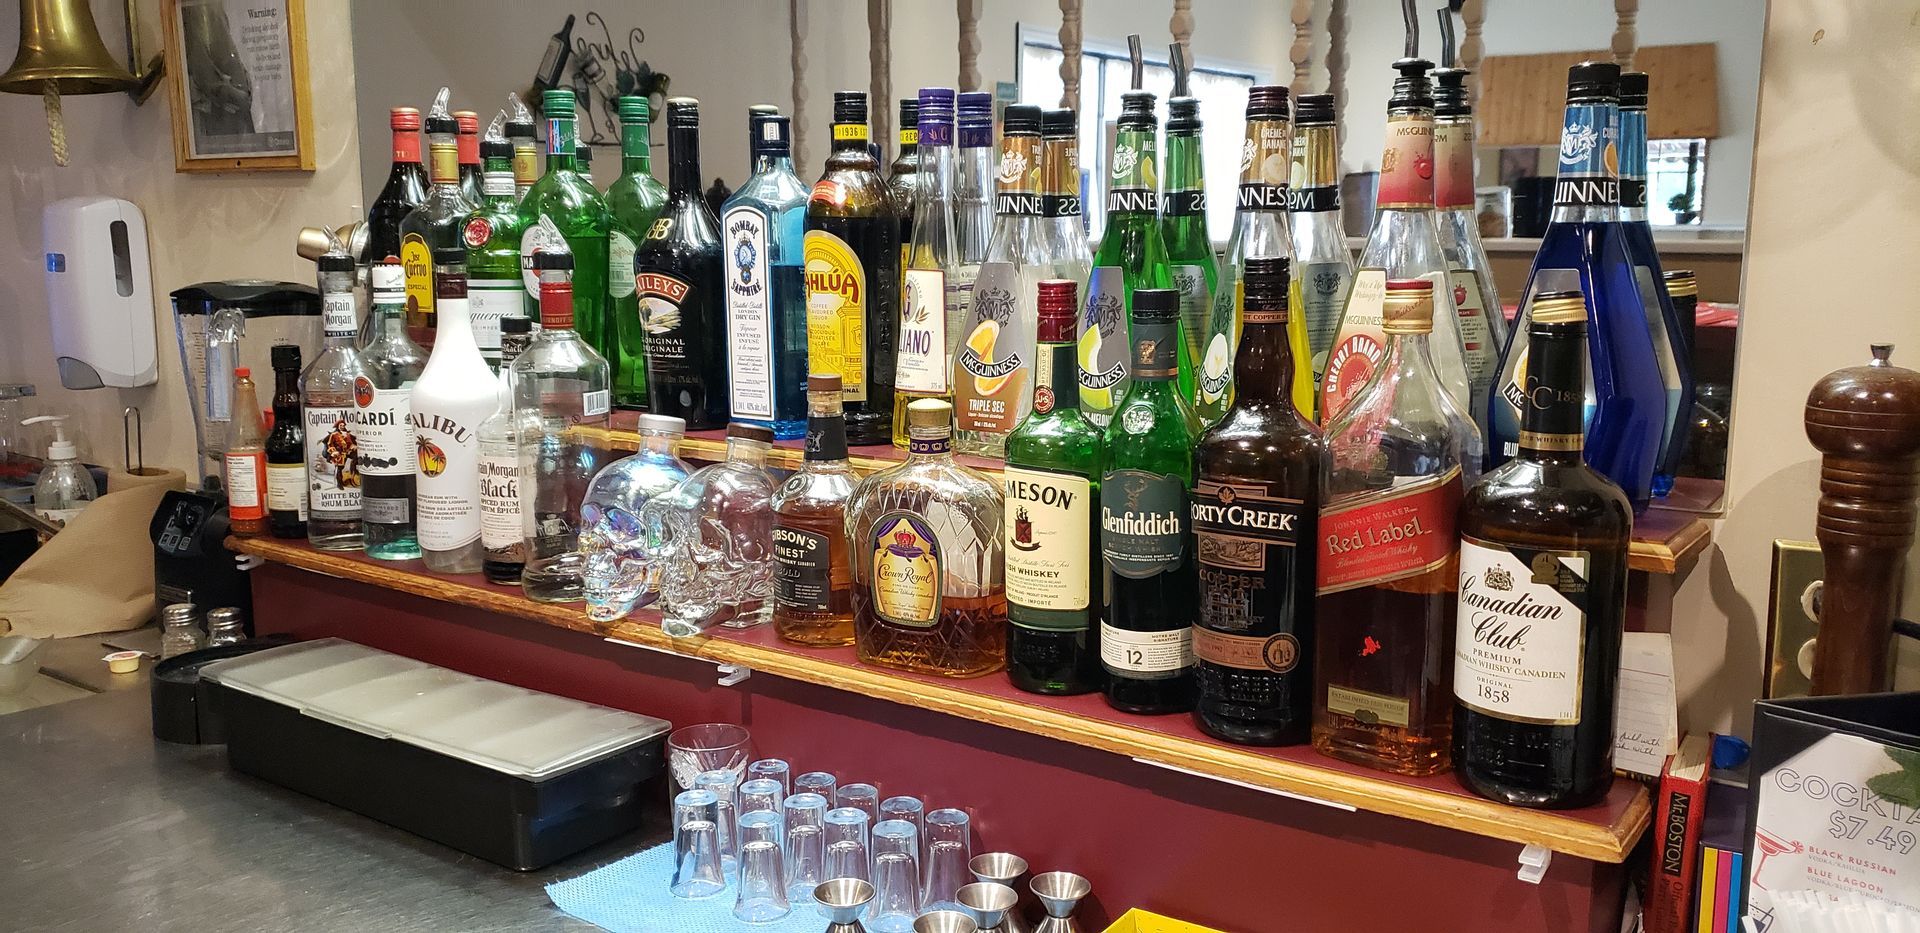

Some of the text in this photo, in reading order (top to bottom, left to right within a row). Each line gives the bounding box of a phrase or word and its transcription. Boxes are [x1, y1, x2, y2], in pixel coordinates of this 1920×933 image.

[247, 7, 278, 18] Warning:
[730, 220, 759, 239] BOMBAY
[404, 259, 427, 279] Cuervo
[731, 279, 761, 296] SAPPHIRE
[324, 313, 353, 326] Morgan
[969, 398, 1005, 414] TRIPLE SEC
[308, 410, 337, 427] Captain
[487, 462, 519, 479] Morgan
[321, 492, 346, 500] WHITE
[480, 478, 518, 499] Black
[321, 499, 342, 508] RHUM
[499, 499, 520, 507] RUM
[1102, 506, 1180, 536] Glenfiddich
[1227, 505, 1294, 532] CREEK
[1326, 516, 1424, 557] Red Label
[775, 544, 805, 559] FINEST
[878, 563, 934, 585] Crown Royal
[1017, 566, 1060, 578] WHISKEY
[1460, 571, 1564, 621] Canadian
[1471, 611, 1532, 650] Club
[1126, 650, 1143, 666] 12
[1472, 647, 1522, 665] PREMIUM
[1478, 658, 1513, 674] WHISKY
[1514, 668, 1566, 680] CANADIEN
[1476, 675, 1513, 690] ORIGINAL
[1477, 683, 1511, 704] 1858
[1828, 810, 1917, 855] $7.49
[1809, 845, 1897, 876] BLACK RUSSIAN
[1807, 866, 1884, 894] BLUE LAGOON
